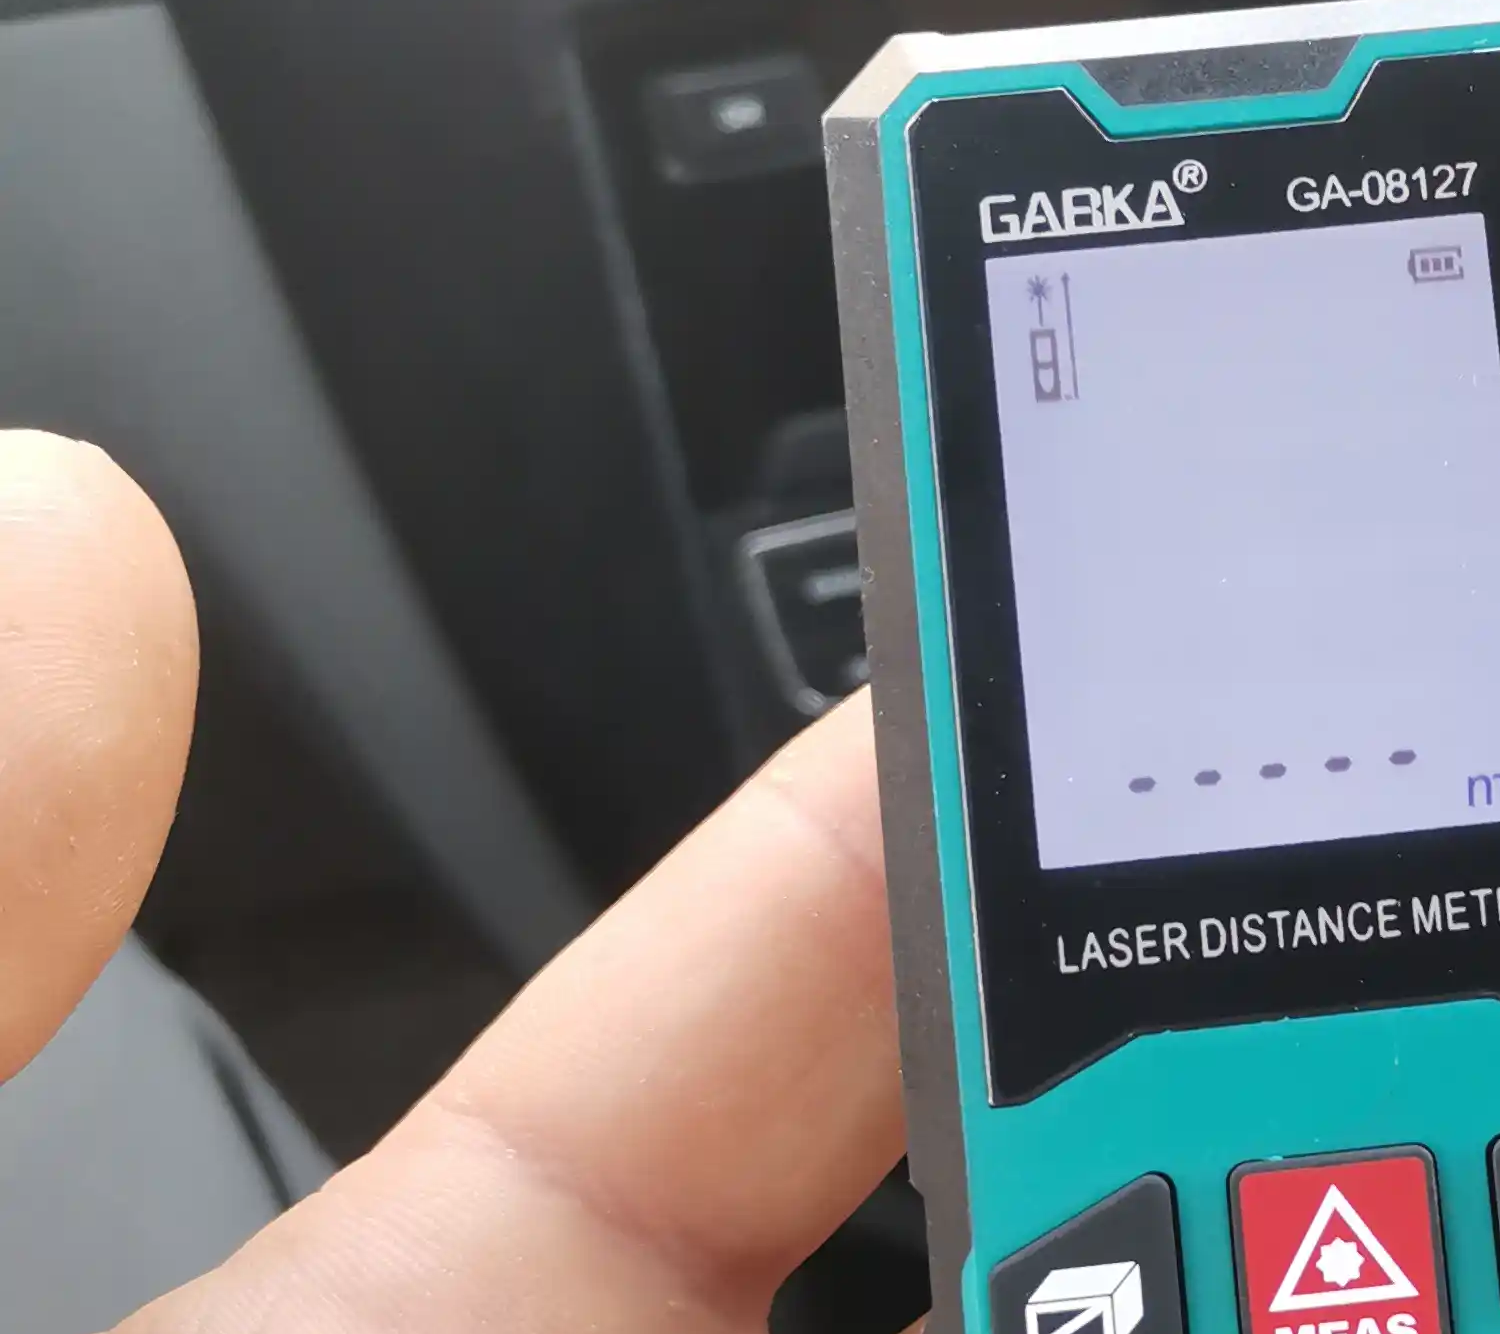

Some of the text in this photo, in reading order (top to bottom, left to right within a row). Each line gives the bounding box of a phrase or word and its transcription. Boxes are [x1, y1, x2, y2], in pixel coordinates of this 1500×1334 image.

[1286, 162, 1478, 213] GA-08127
[1057, 921, 1191, 974] LASER
[1200, 899, 1402, 959] DISTANCE
